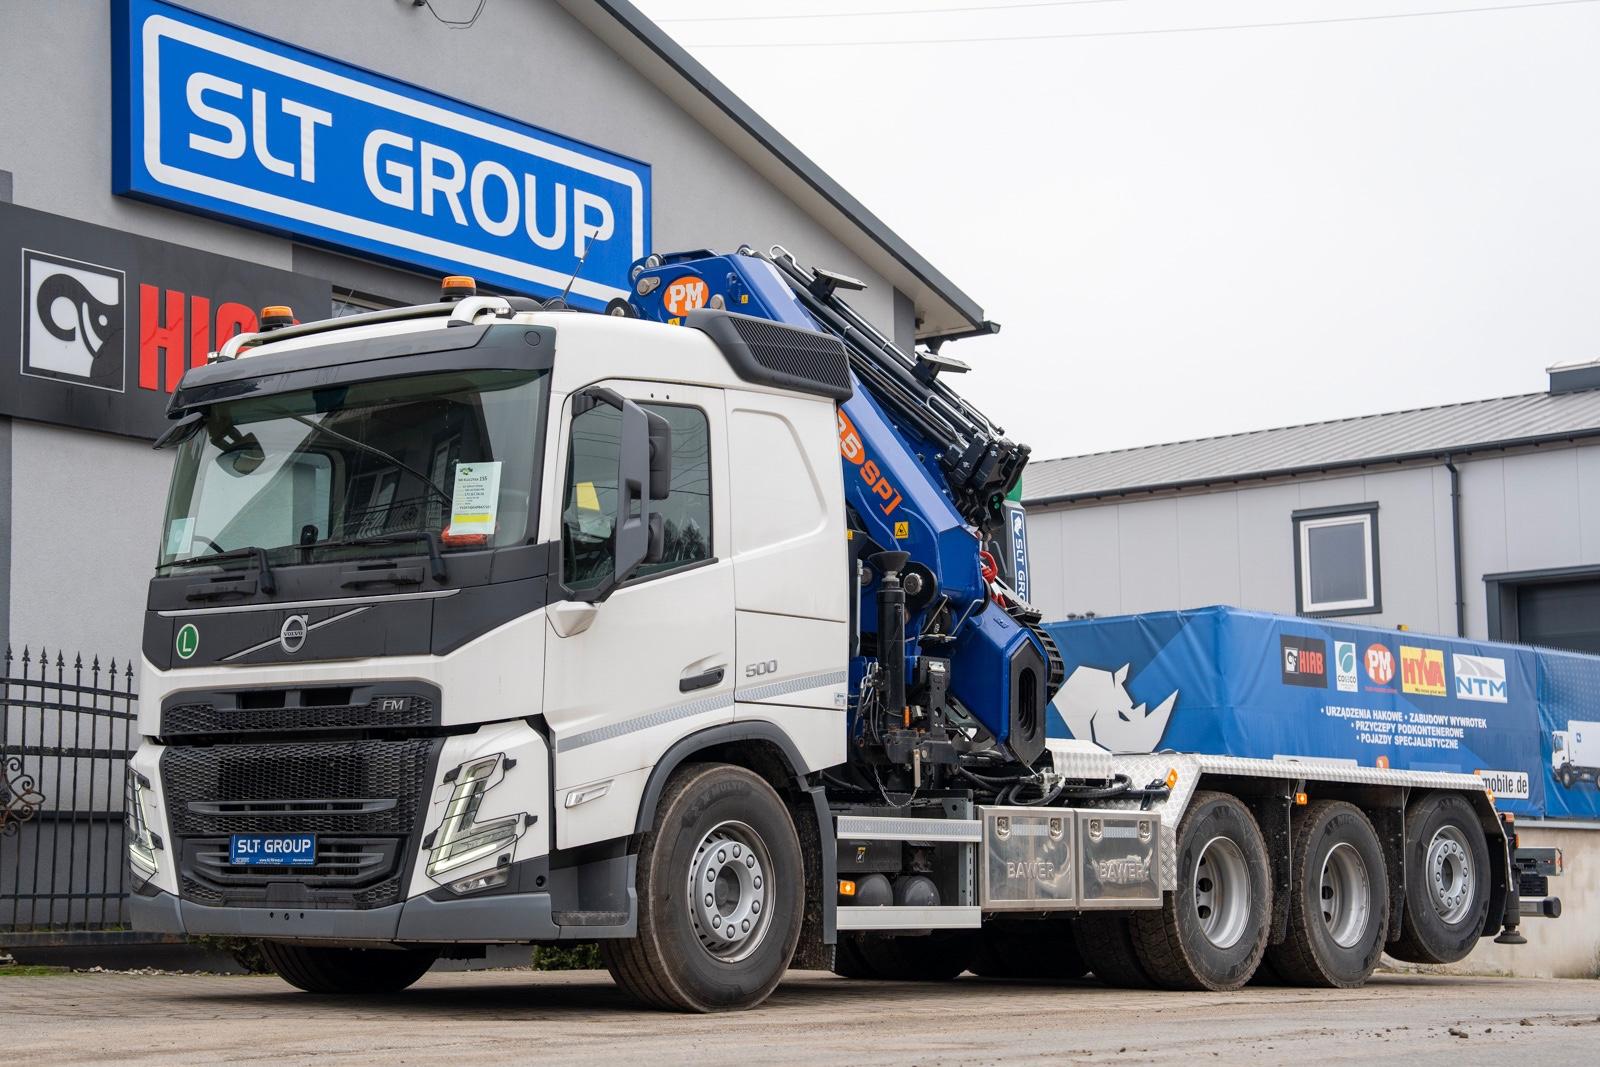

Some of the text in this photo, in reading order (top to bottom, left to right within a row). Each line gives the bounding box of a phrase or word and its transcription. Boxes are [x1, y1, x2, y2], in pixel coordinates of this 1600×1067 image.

[186, 72, 615, 259] SLT GROUP
[668, 281, 704, 313] PM
[1015, 538, 1025, 566] SLT
[182, 631, 192, 653] L
[745, 659, 778, 678] 500
[1299, 650, 1324, 675] HIAB
[1367, 649, 1393, 682] PM
[1402, 648, 1445, 687] HYVA
[1455, 676, 1507, 698] NTM
[382, 699, 404, 711] FM
[1355, 720, 1464, 739] PRZYCZEPY PODKONTENEROWE
[1372, 709, 1403, 722] HAKOWE
[1409, 712, 1449, 726] ZABUDOWY
[1449, 716, 1488, 729] WYWROTEK
[1360, 733, 1459, 749] POJAZDY SPECJALISTYCZNE
[237, 839, 312, 853] SLT GROUP
[1006, 862, 1056, 880] BAWER
